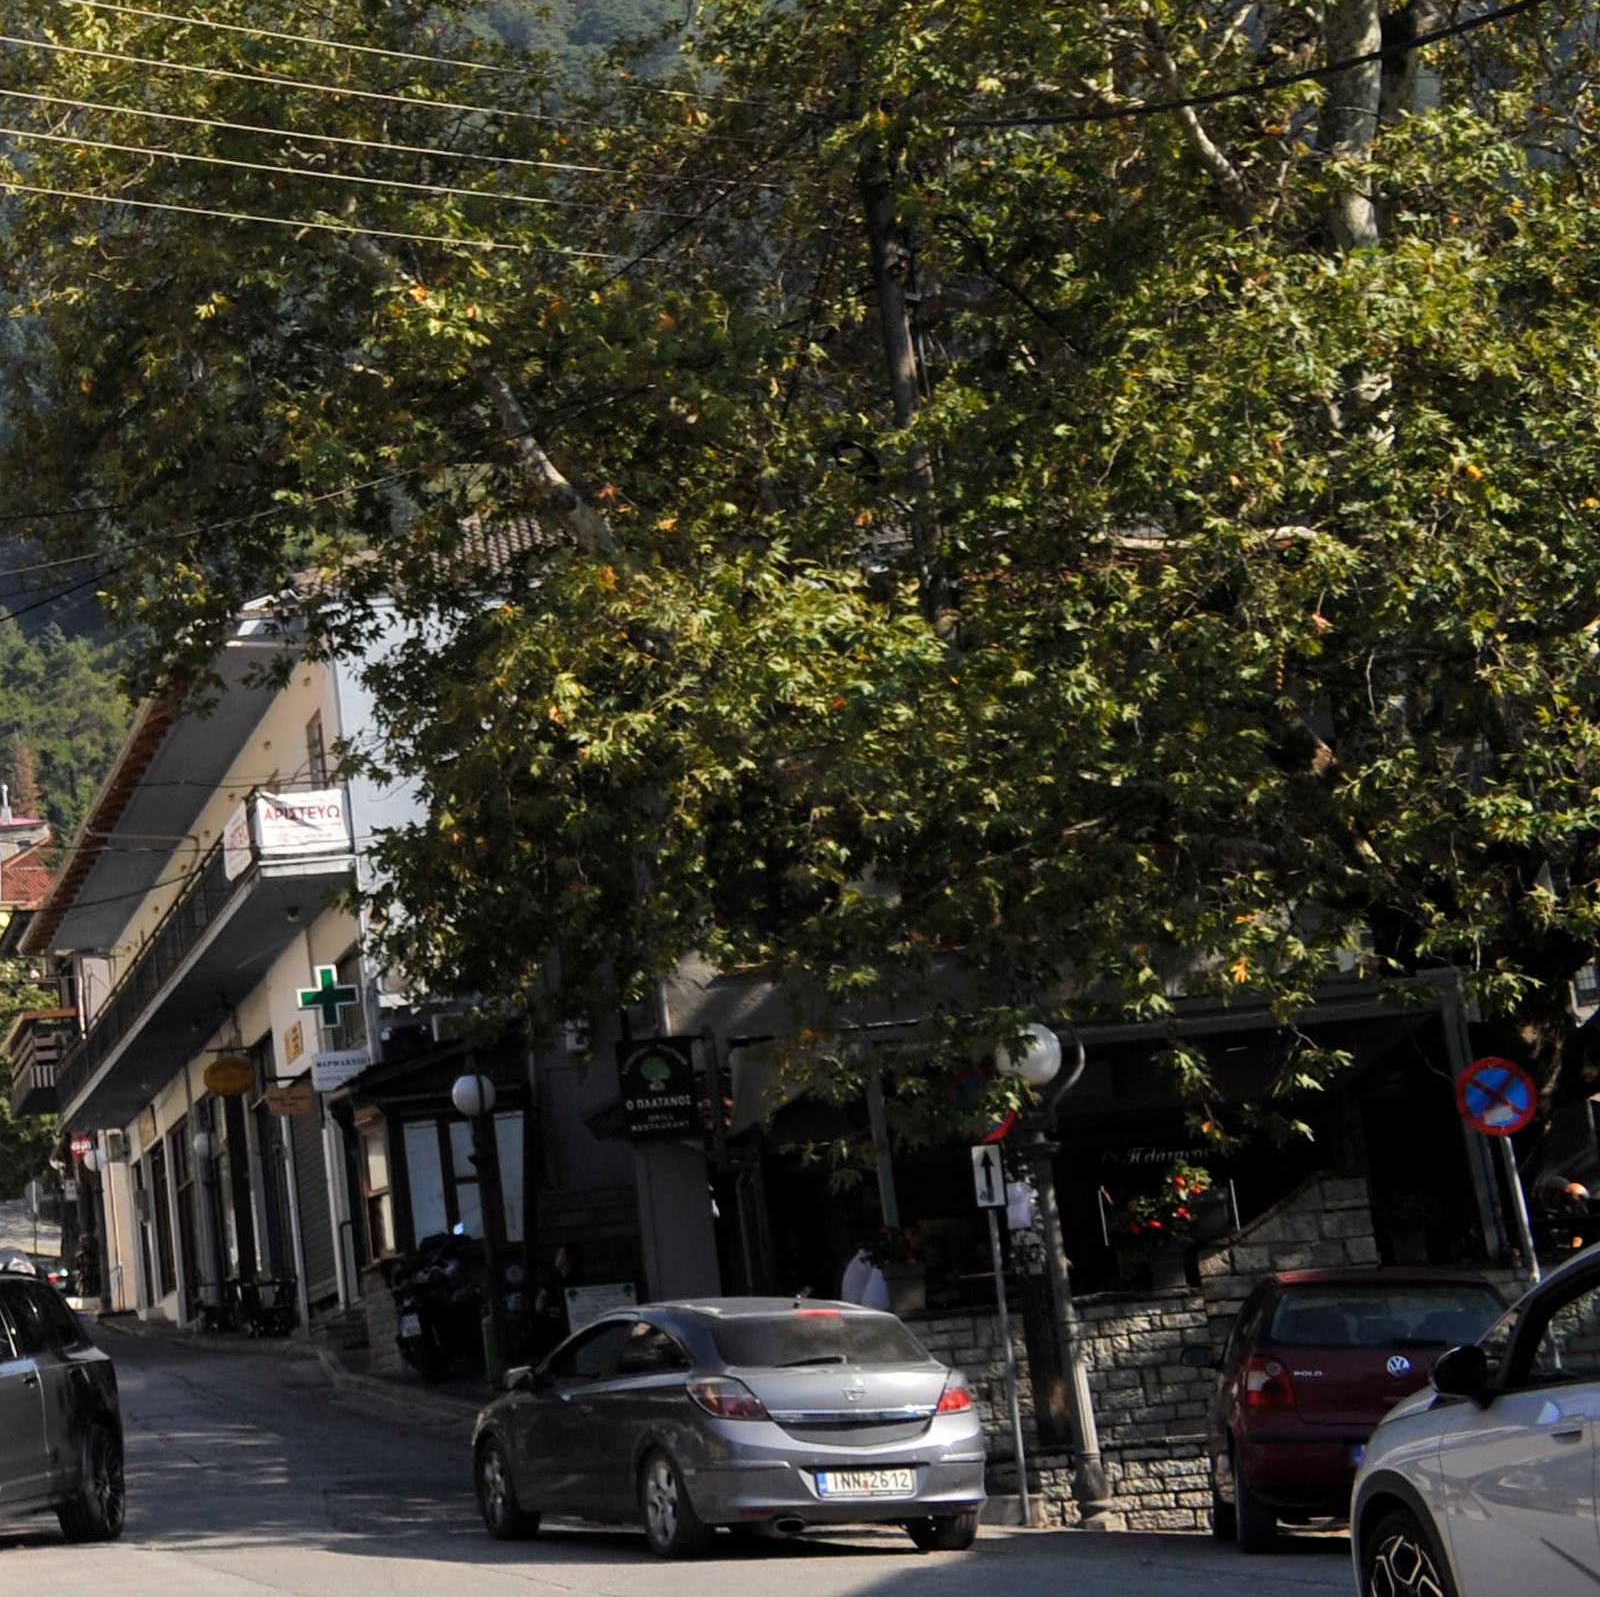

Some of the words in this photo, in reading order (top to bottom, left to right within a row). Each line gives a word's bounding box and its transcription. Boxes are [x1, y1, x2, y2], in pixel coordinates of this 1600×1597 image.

[264, 804, 341, 822] ΑΡΙΣΤΕΥΩ
[625, 1100, 634, 1111] Ο
[636, 1094, 693, 1110] ΠΛΑΤΑΝΟΣ
